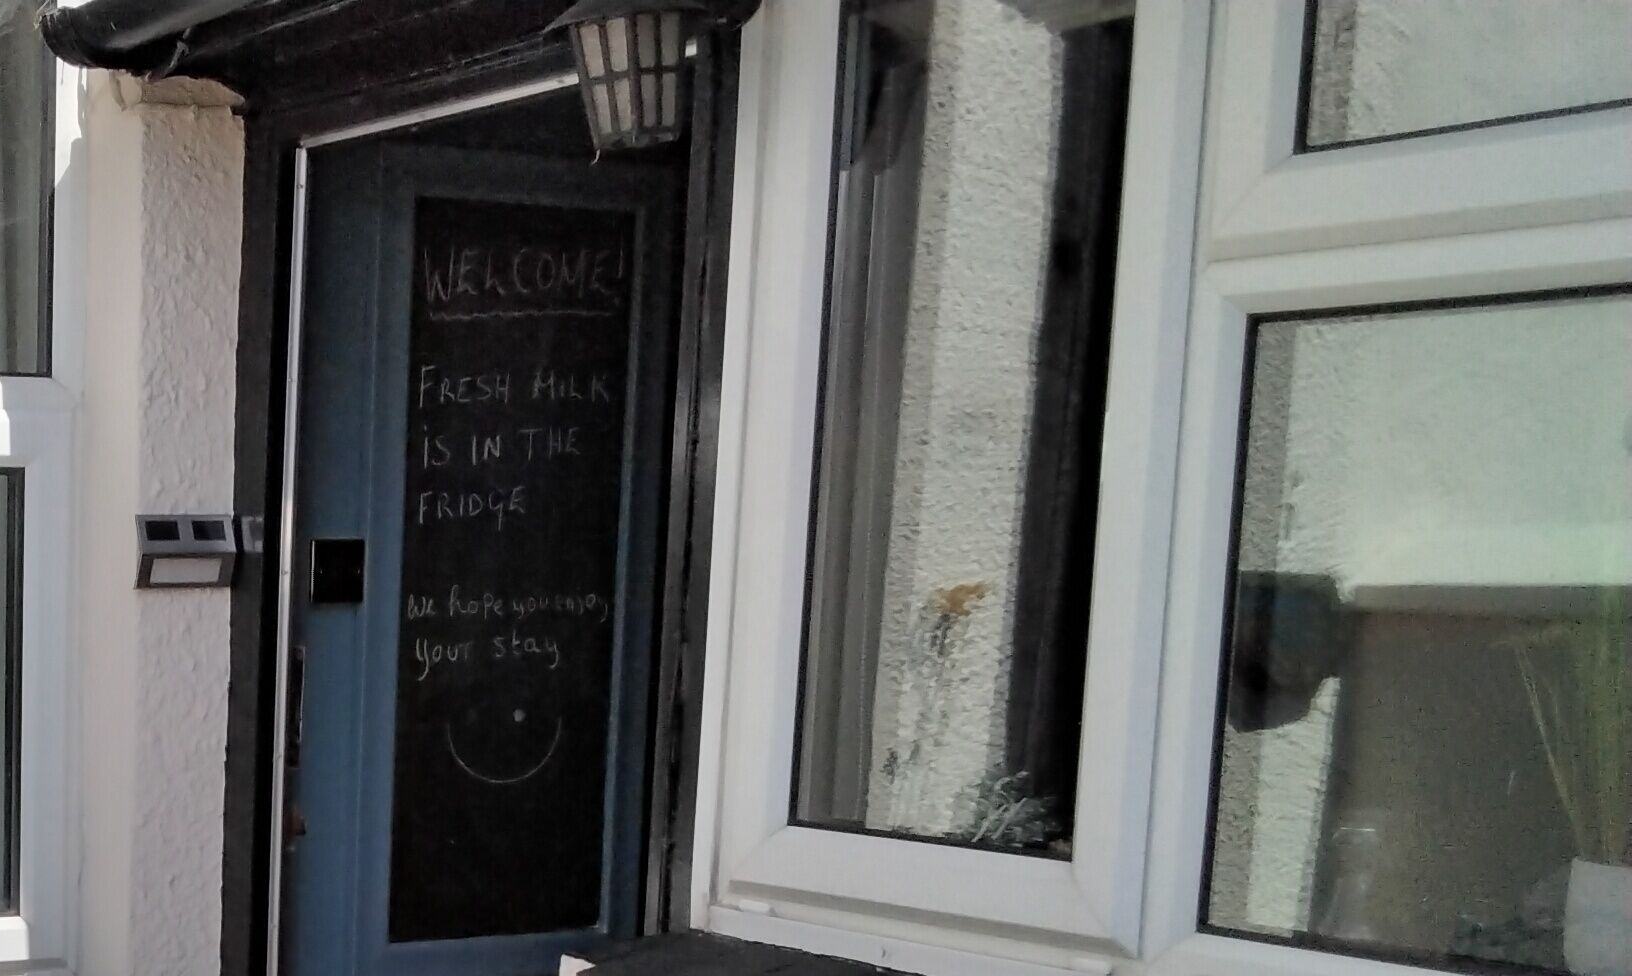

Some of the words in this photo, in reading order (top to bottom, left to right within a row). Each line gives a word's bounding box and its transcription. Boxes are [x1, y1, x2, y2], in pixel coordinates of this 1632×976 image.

[424, 240, 624, 306] WELCOME!
[419, 365, 511, 408] FRESH
[471, 434, 503, 466] IN
[519, 426, 581, 461] THE
[419, 485, 526, 531] FRIDGE
[449, 584, 504, 620] hope
[512, 595, 549, 620] you
[493, 628, 560, 669] stay
